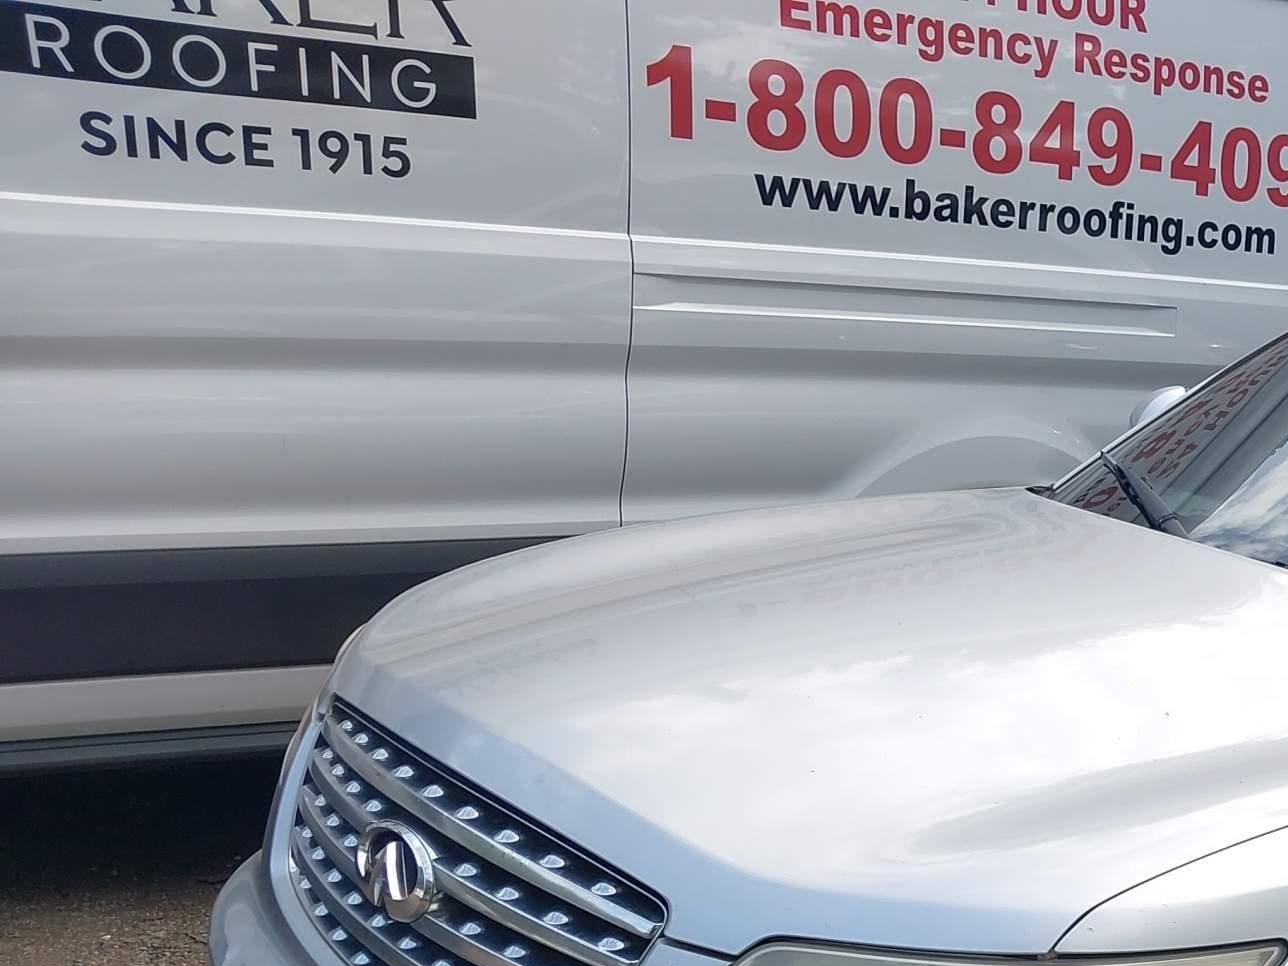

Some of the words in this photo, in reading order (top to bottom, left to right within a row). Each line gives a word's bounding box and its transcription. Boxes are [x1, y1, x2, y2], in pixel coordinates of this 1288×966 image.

[24, 13, 437, 108] ROOFING
[779, 0, 1059, 79] Emergency
[1075, 33, 1270, 103] Response
[79, 111, 275, 168] SINCE
[291, 127, 412, 178] 1915
[754, 172, 1277, 256] www.bakerroofing.com
